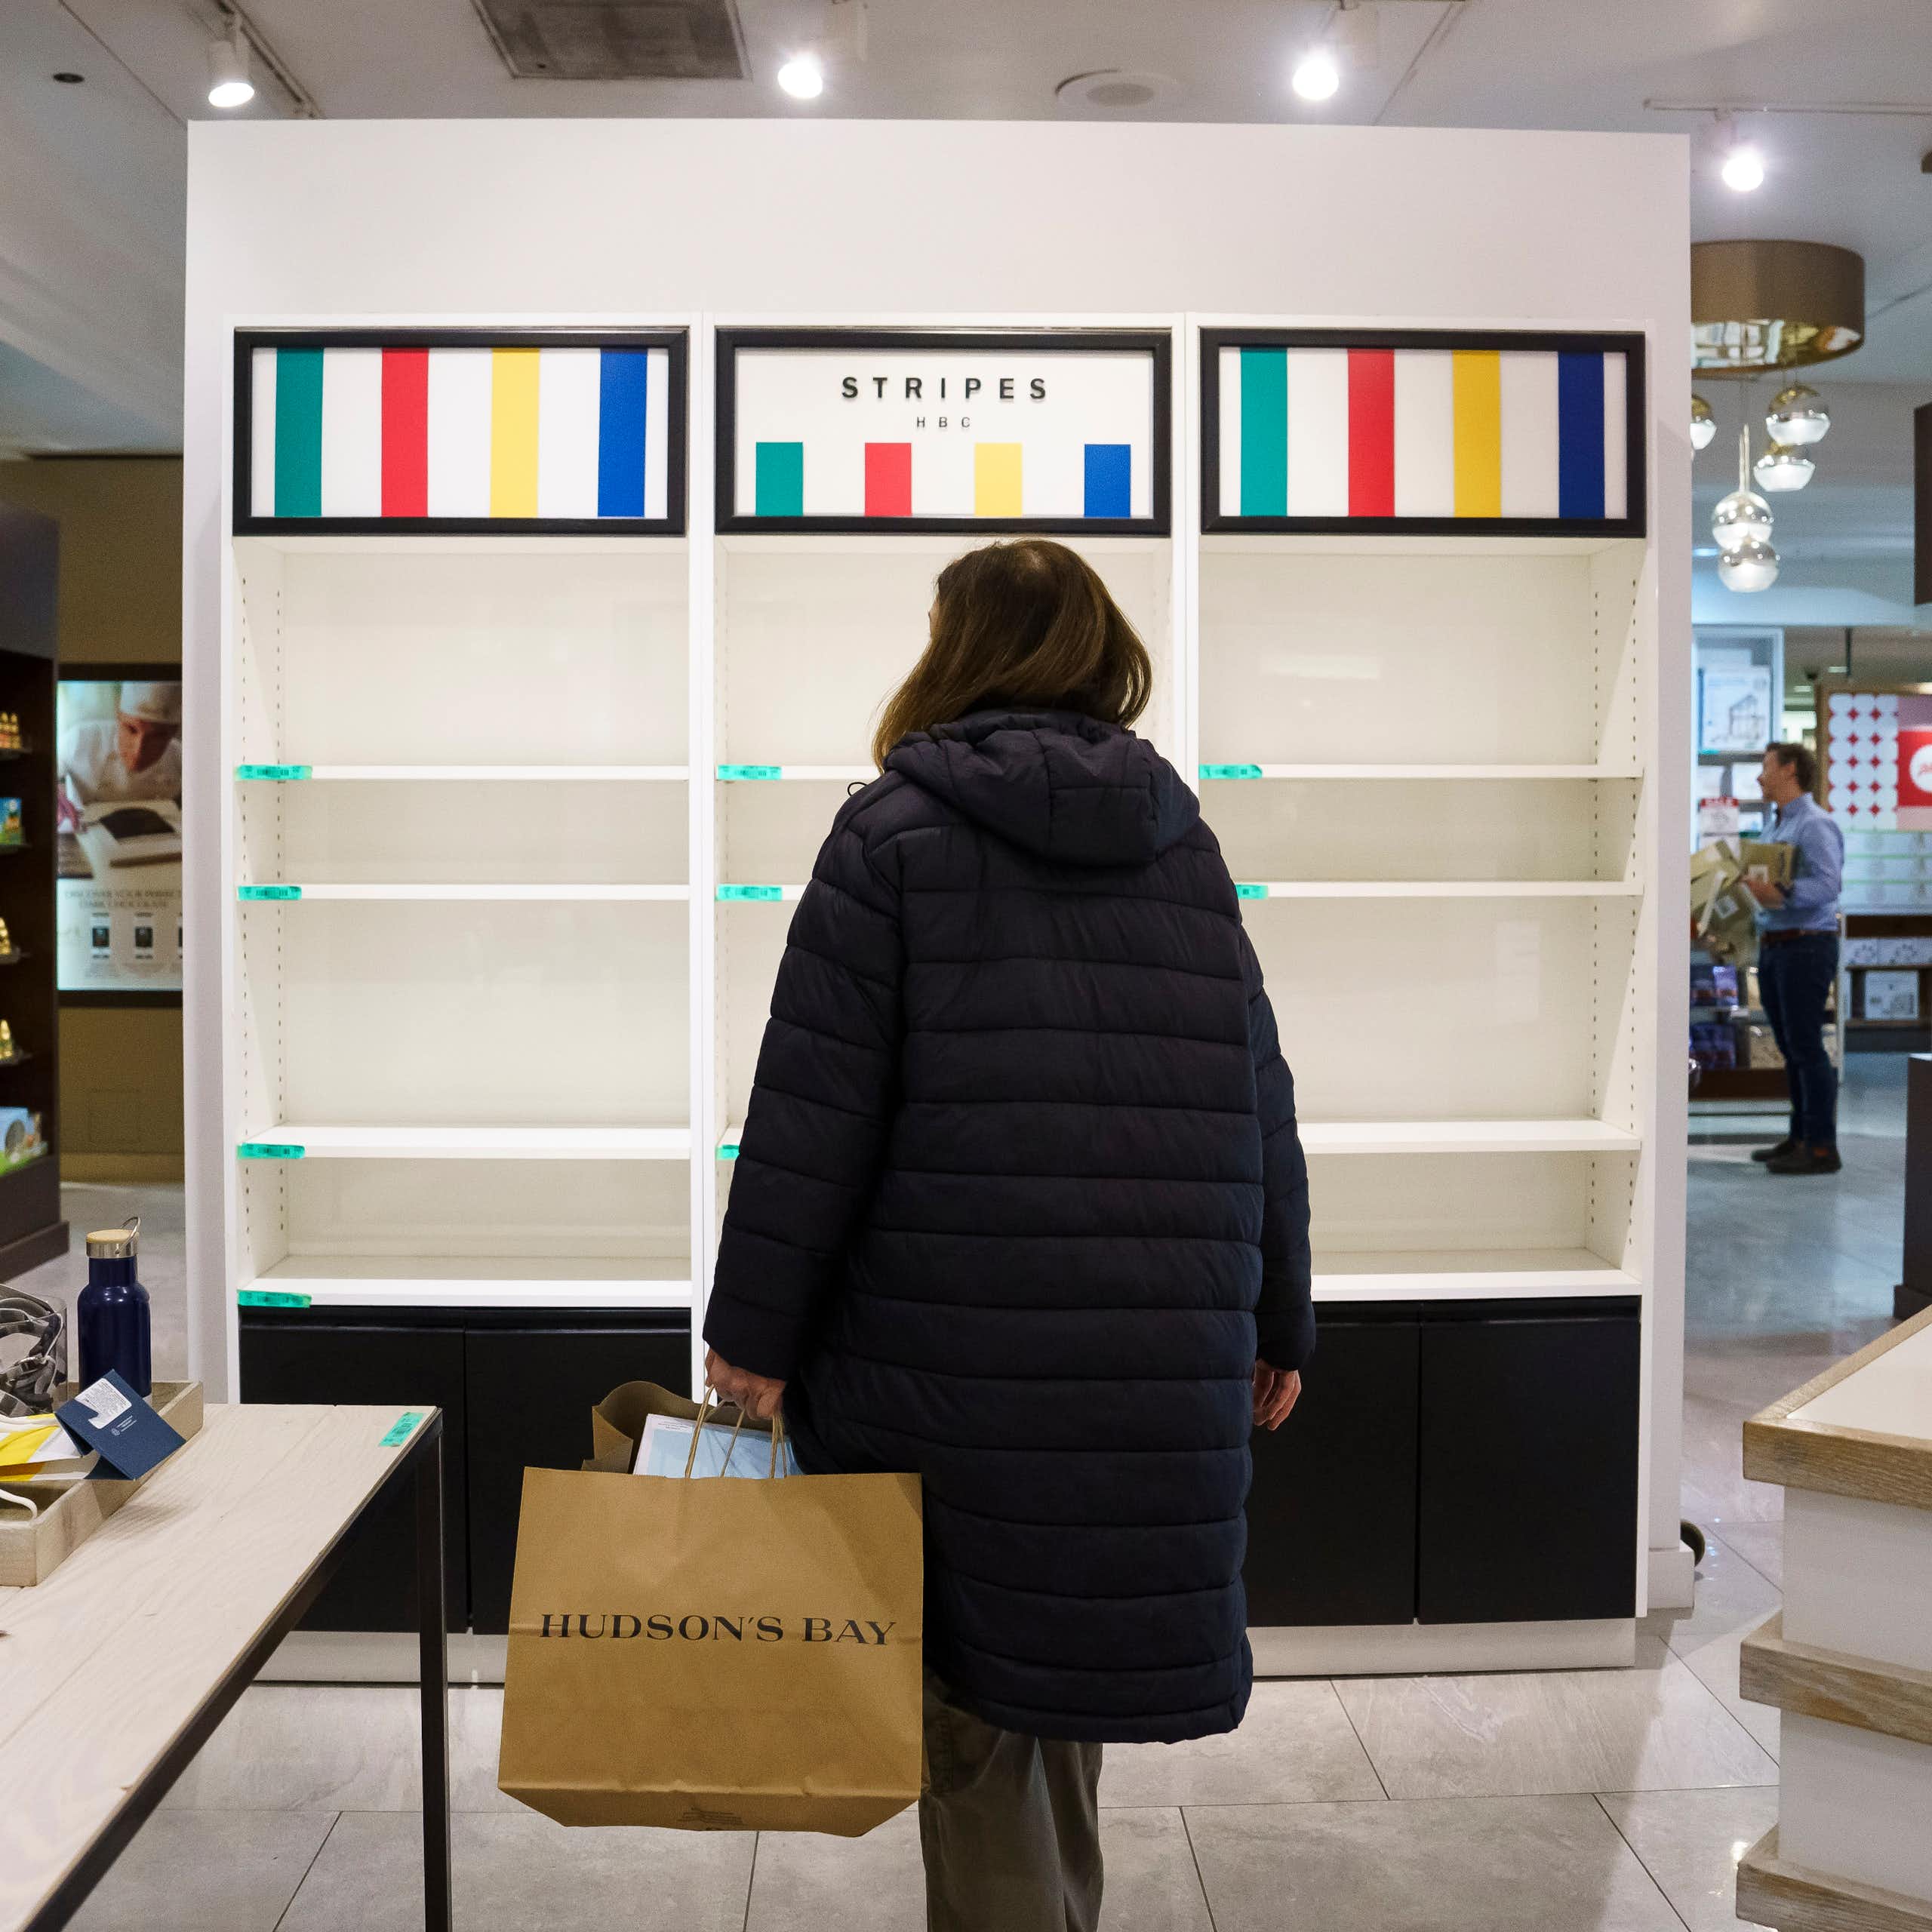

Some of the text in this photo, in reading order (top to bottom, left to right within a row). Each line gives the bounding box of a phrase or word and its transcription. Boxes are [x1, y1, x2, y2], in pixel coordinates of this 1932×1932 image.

[841, 377, 1047, 399] STRIPES
[916, 417, 971, 429] HBC
[539, 1613, 897, 1647] HUDSON'S BAY
